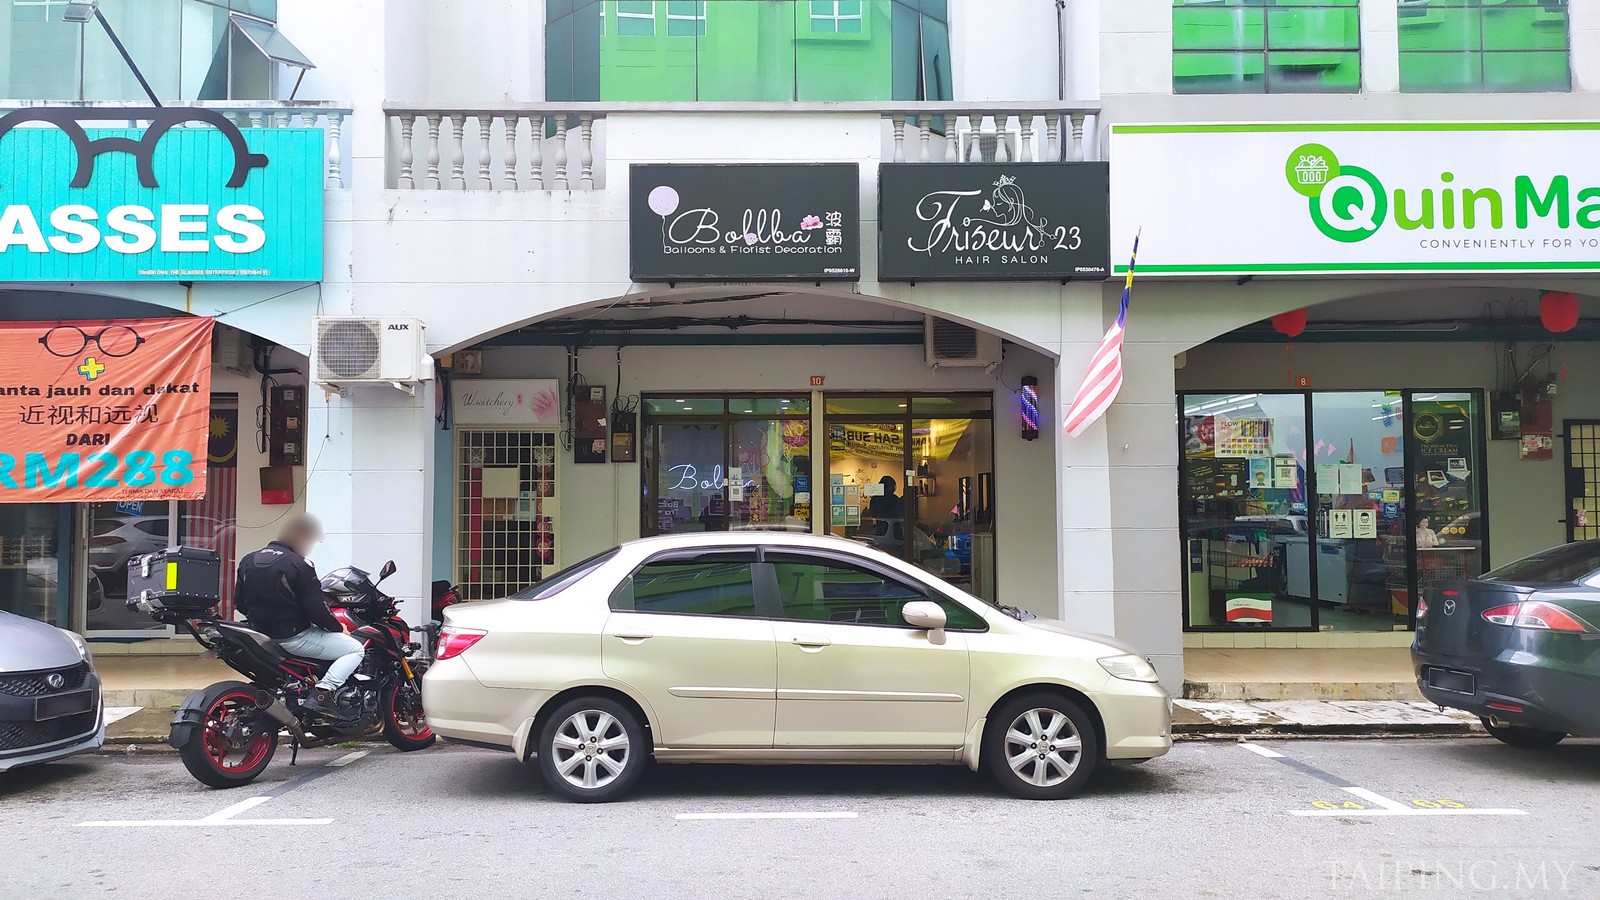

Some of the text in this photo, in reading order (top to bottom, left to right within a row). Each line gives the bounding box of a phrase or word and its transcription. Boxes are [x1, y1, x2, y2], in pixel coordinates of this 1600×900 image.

[0, 203, 267, 254] ASSES
[825, 210, 843, 246] 波霸
[1053, 225, 1082, 251] 23
[1419, 238, 1536, 249] CONVENIENTLY
[1542, 238, 1572, 248] FOR
[663, 245, 843, 254] Balloons & Florist Decoration
[955, 255, 1048, 264] HAIR SALON
[811, 377, 822, 386] 10
[1300, 377, 1306, 386] 8
[0, 382, 200, 399] anta jauh dan dekat
[18, 403, 159, 426] 近视和远视
[66, 433, 111, 446] DARI
[1420, 447, 1459, 455] ICE CREAM
[119, 500, 144, 512] OPEN
